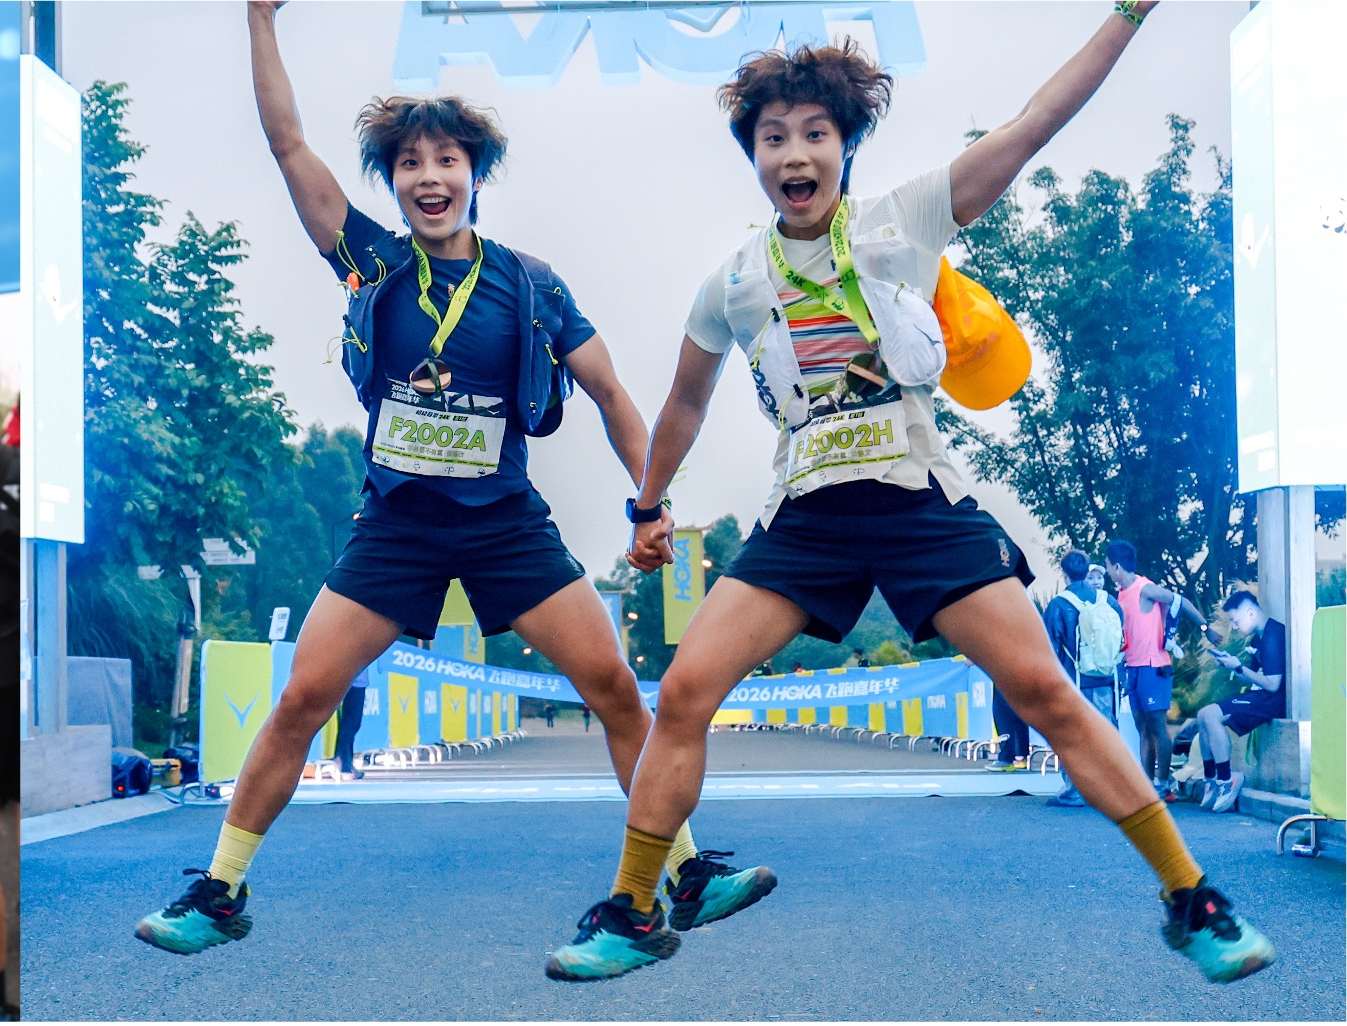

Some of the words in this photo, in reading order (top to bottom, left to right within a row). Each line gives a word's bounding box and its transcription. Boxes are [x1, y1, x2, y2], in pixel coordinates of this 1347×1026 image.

[786, 271, 806, 288] 24K
[388, 416, 486, 451] F2002A
[794, 419, 893, 464] F2002H
[673, 538, 692, 601] HOKA
[392, 650, 436, 673] 2026
[436, 659, 485, 682] HOKA
[727, 687, 771, 703] 2026
[771, 684, 822, 702] HOKA
[824, 677, 900, 698] 飞跑嘉年华
